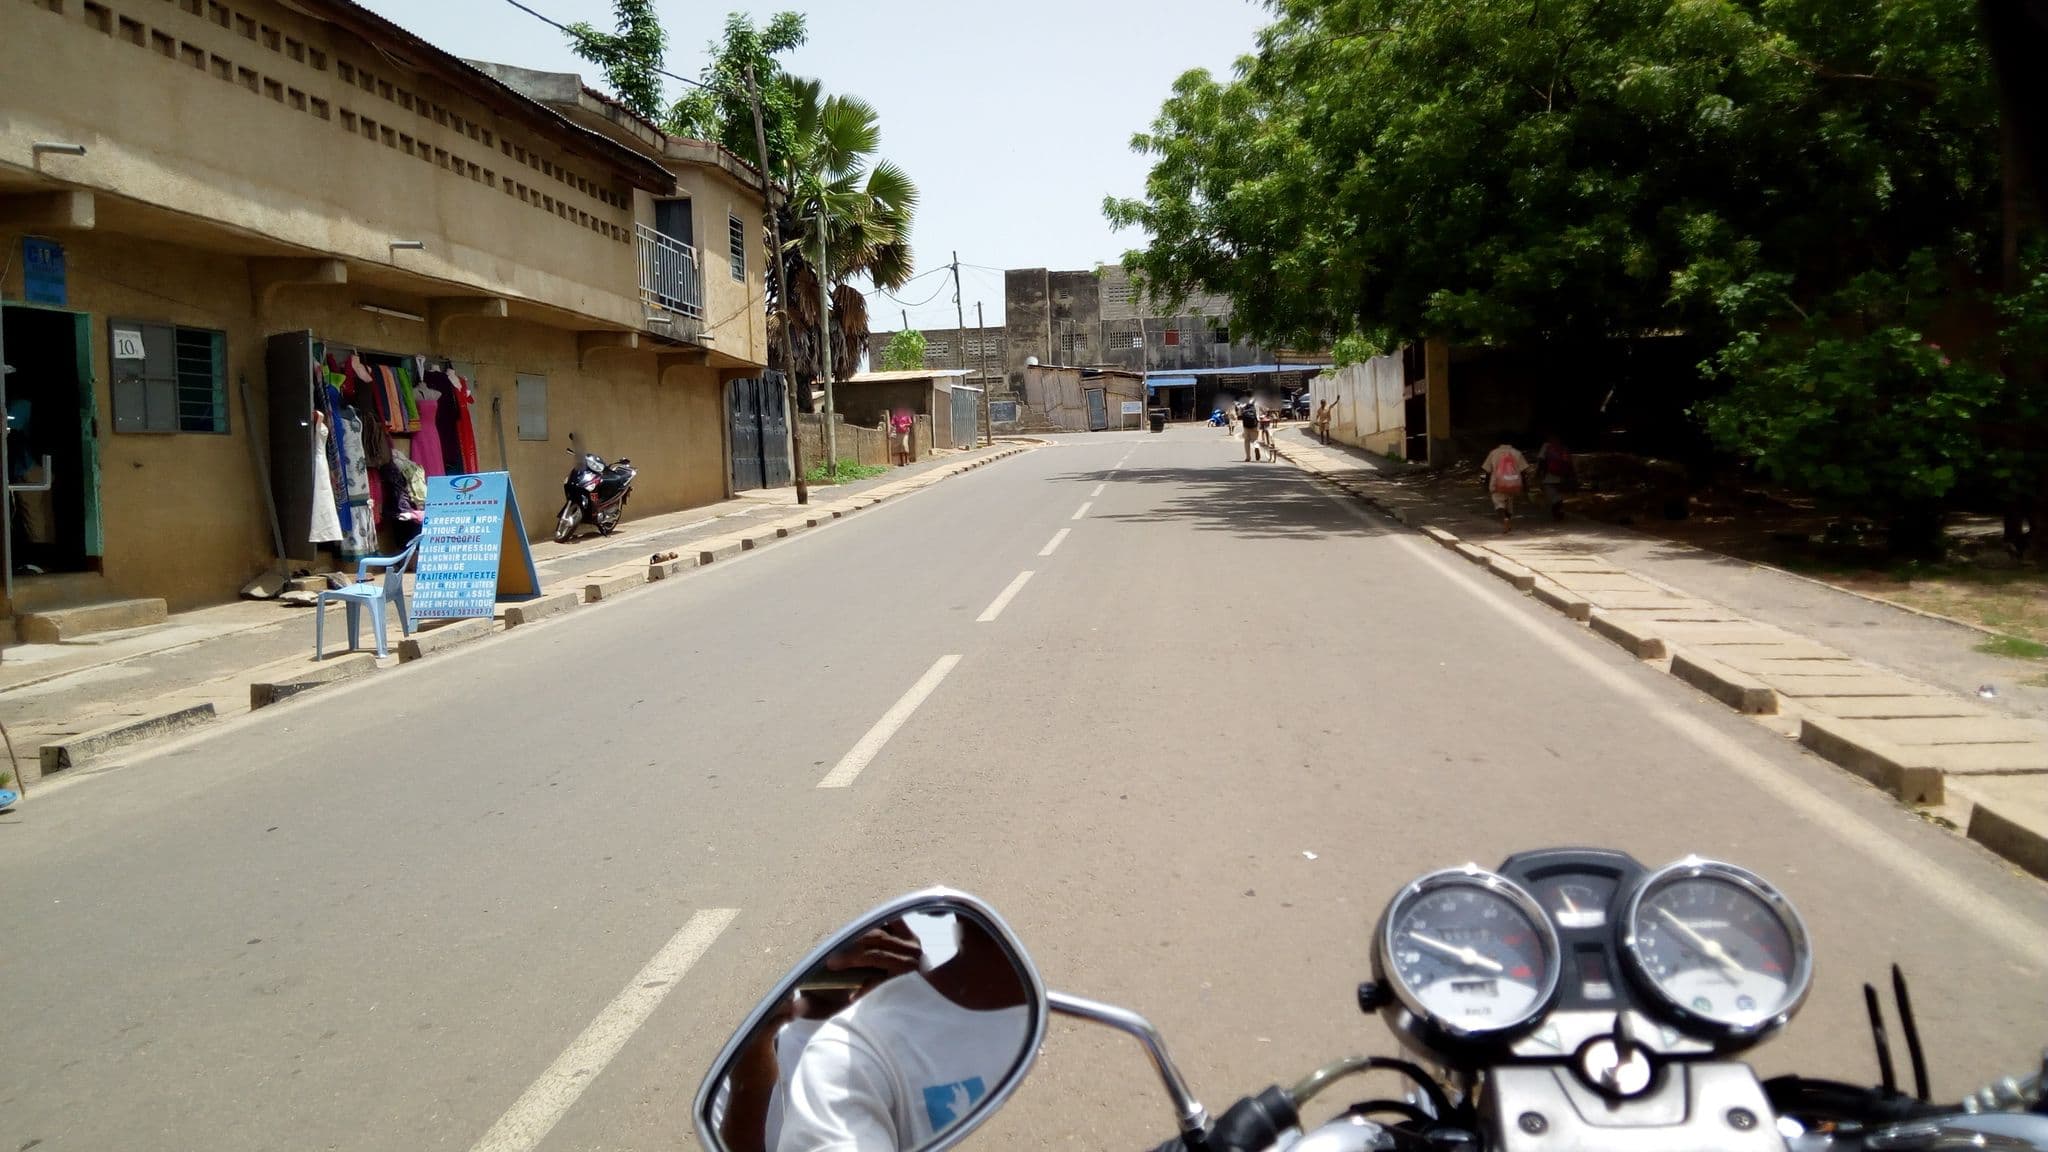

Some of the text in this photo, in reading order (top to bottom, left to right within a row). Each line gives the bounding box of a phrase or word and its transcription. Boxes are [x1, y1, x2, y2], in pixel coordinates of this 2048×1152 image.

[119, 338, 135, 355] 10
[423, 516, 471, 526] CARREFOUR
[421, 525, 490, 536] MATIQUE PASCAL
[429, 535, 481, 544] PHOTOCOPIE
[448, 544, 498, 553] IMPRESSION
[462, 553, 498, 561] COULEUR
[421, 563, 465, 572] SCANNAGE
[416, 572, 463, 581] TRAITEMENT
[468, 571, 496, 579] TEXTE
[412, 599, 493, 608] TANCE INFORMATIQUE
